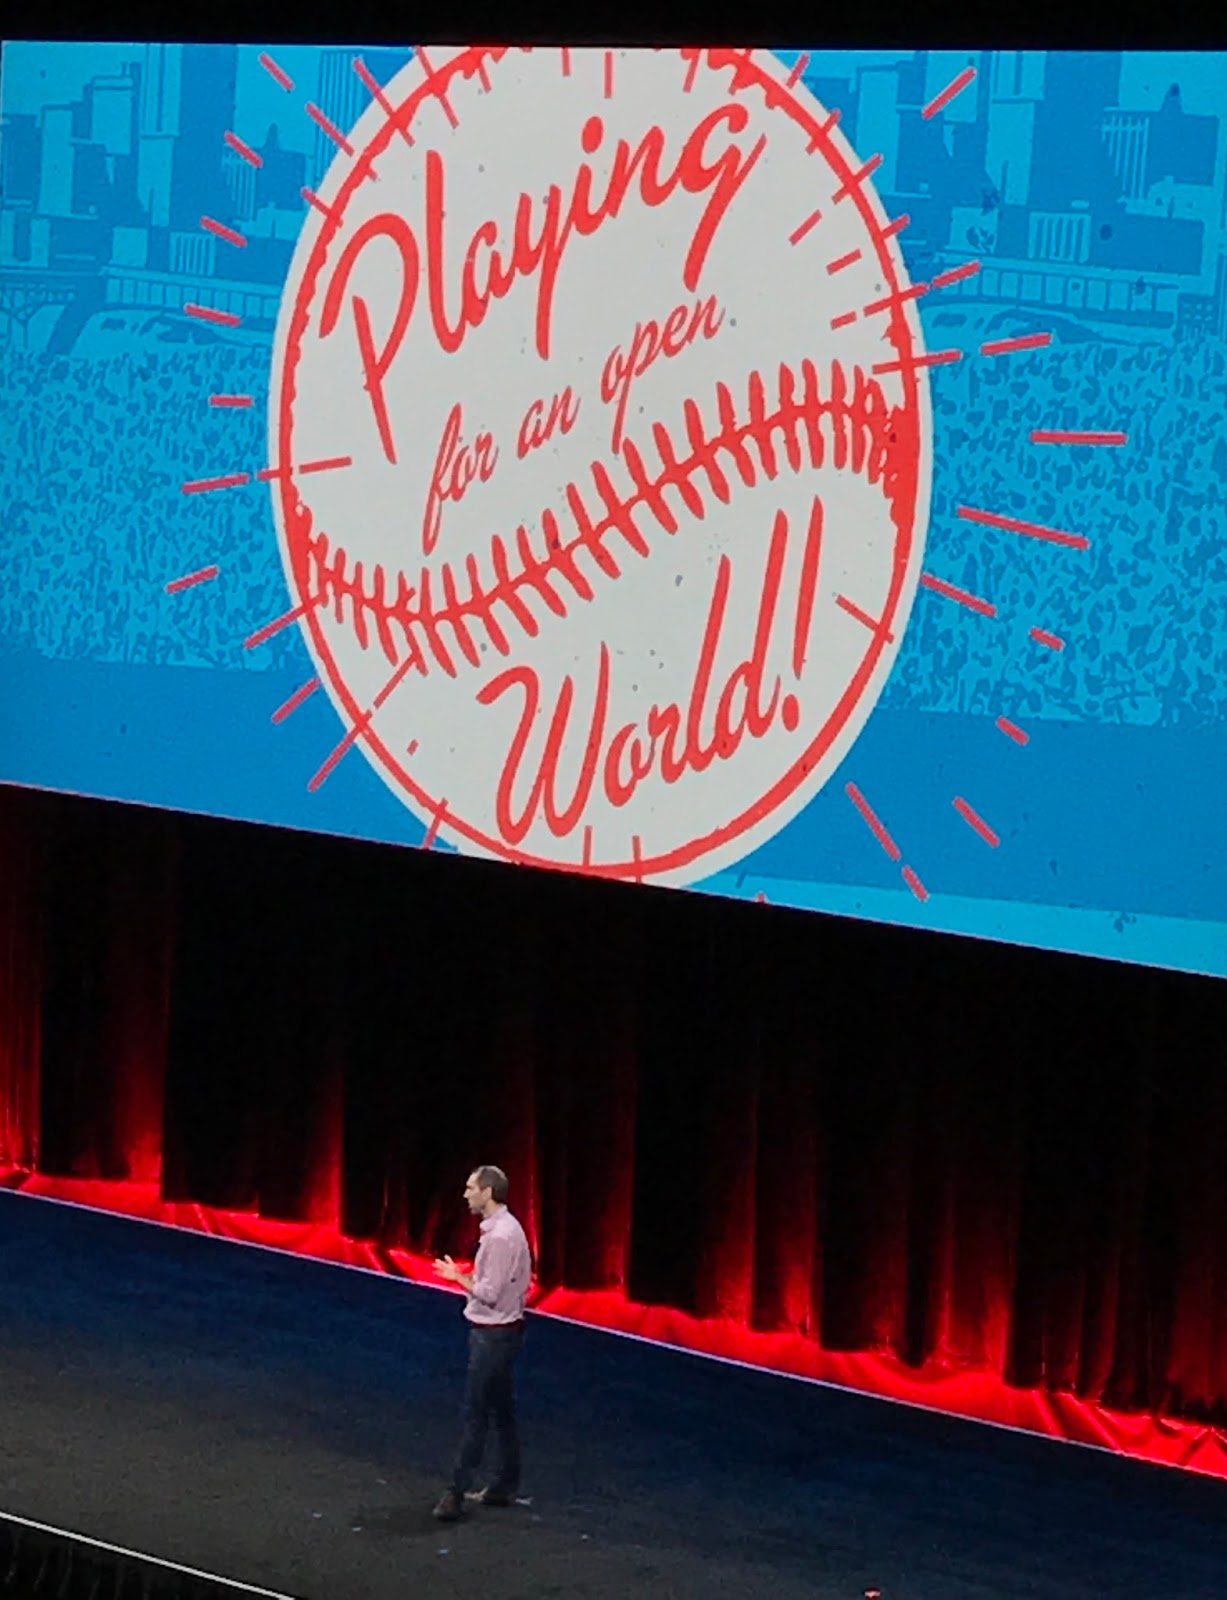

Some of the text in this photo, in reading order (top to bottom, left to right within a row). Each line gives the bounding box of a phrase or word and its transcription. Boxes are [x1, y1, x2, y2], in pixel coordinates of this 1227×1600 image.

[319, 102, 767, 463] Playing
[422, 295, 726, 556] for an open
[476, 497, 824, 846] World!
